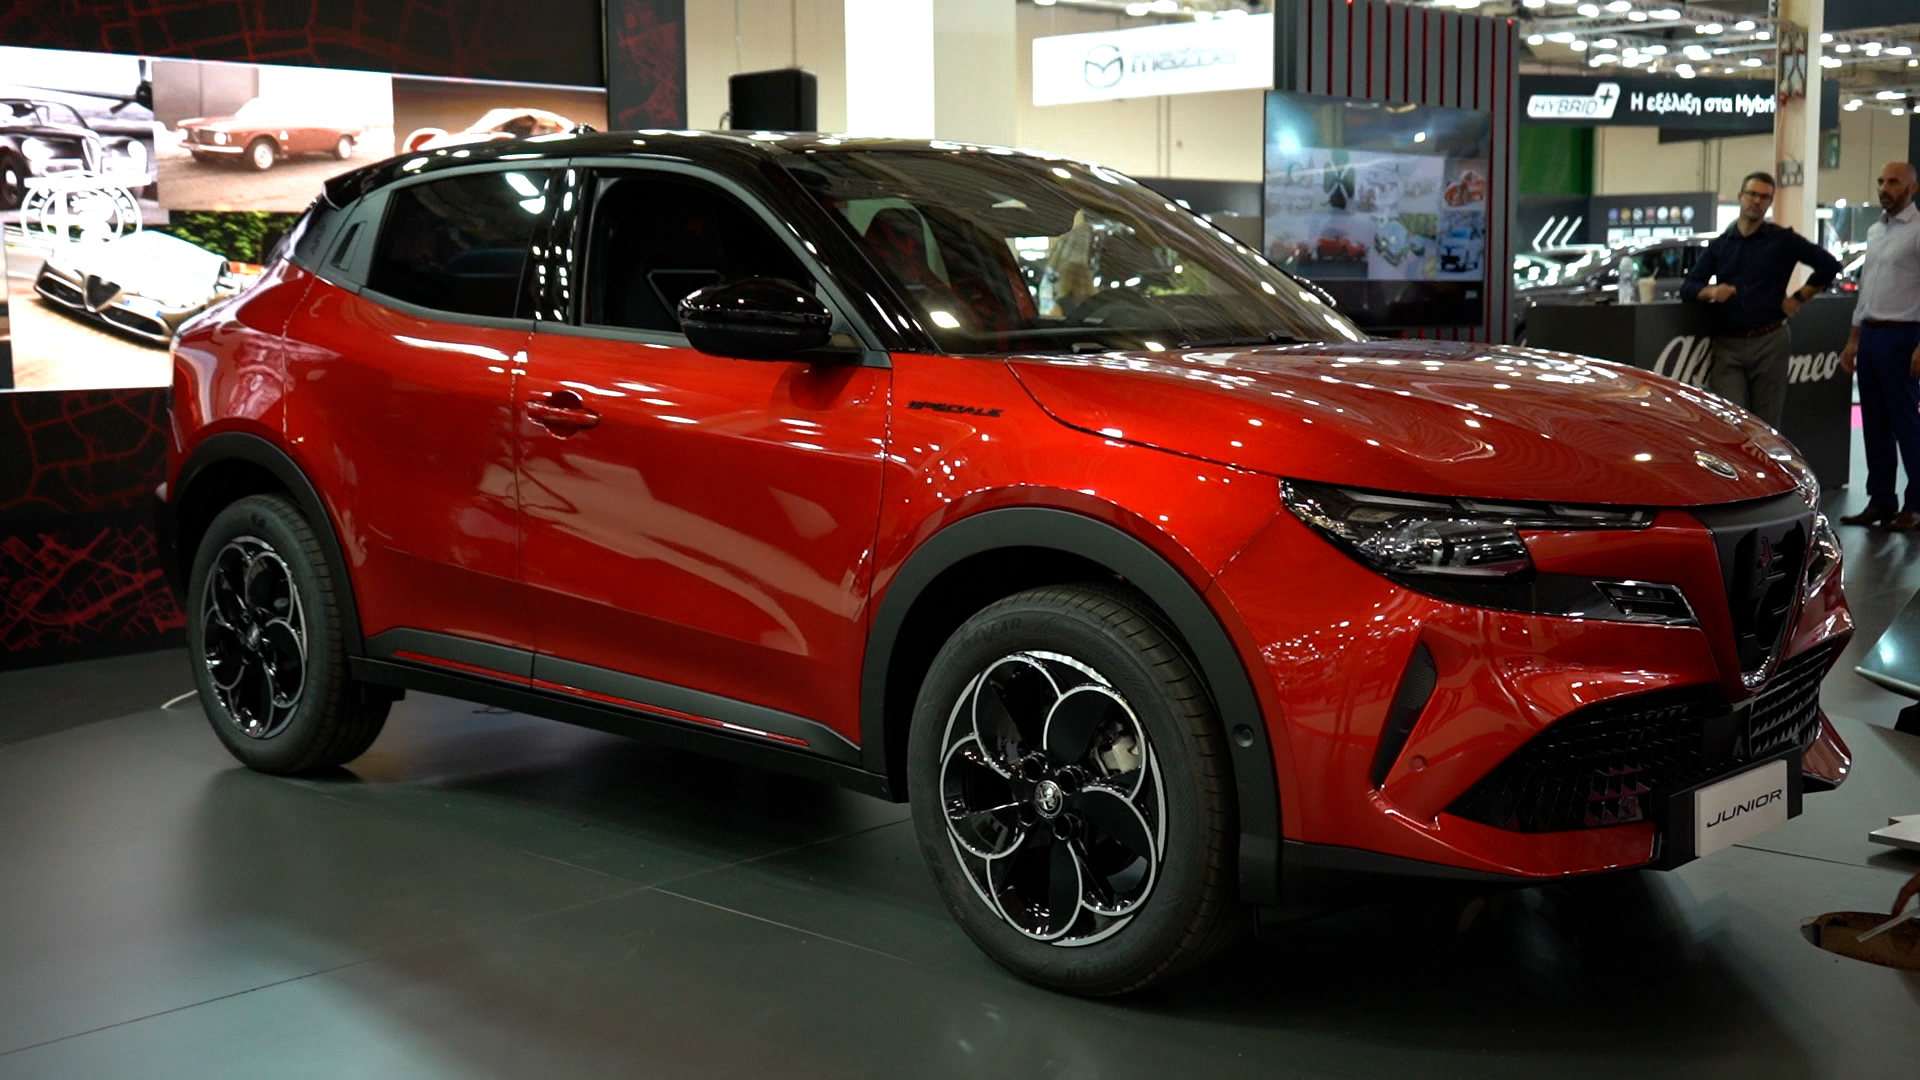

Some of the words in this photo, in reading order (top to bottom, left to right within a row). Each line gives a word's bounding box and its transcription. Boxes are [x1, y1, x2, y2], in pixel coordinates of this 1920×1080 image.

[1704, 97, 1733, 113] στα
[1735, 94, 1776, 117] Hybri
[1706, 788, 1782, 828] JUNIOR
